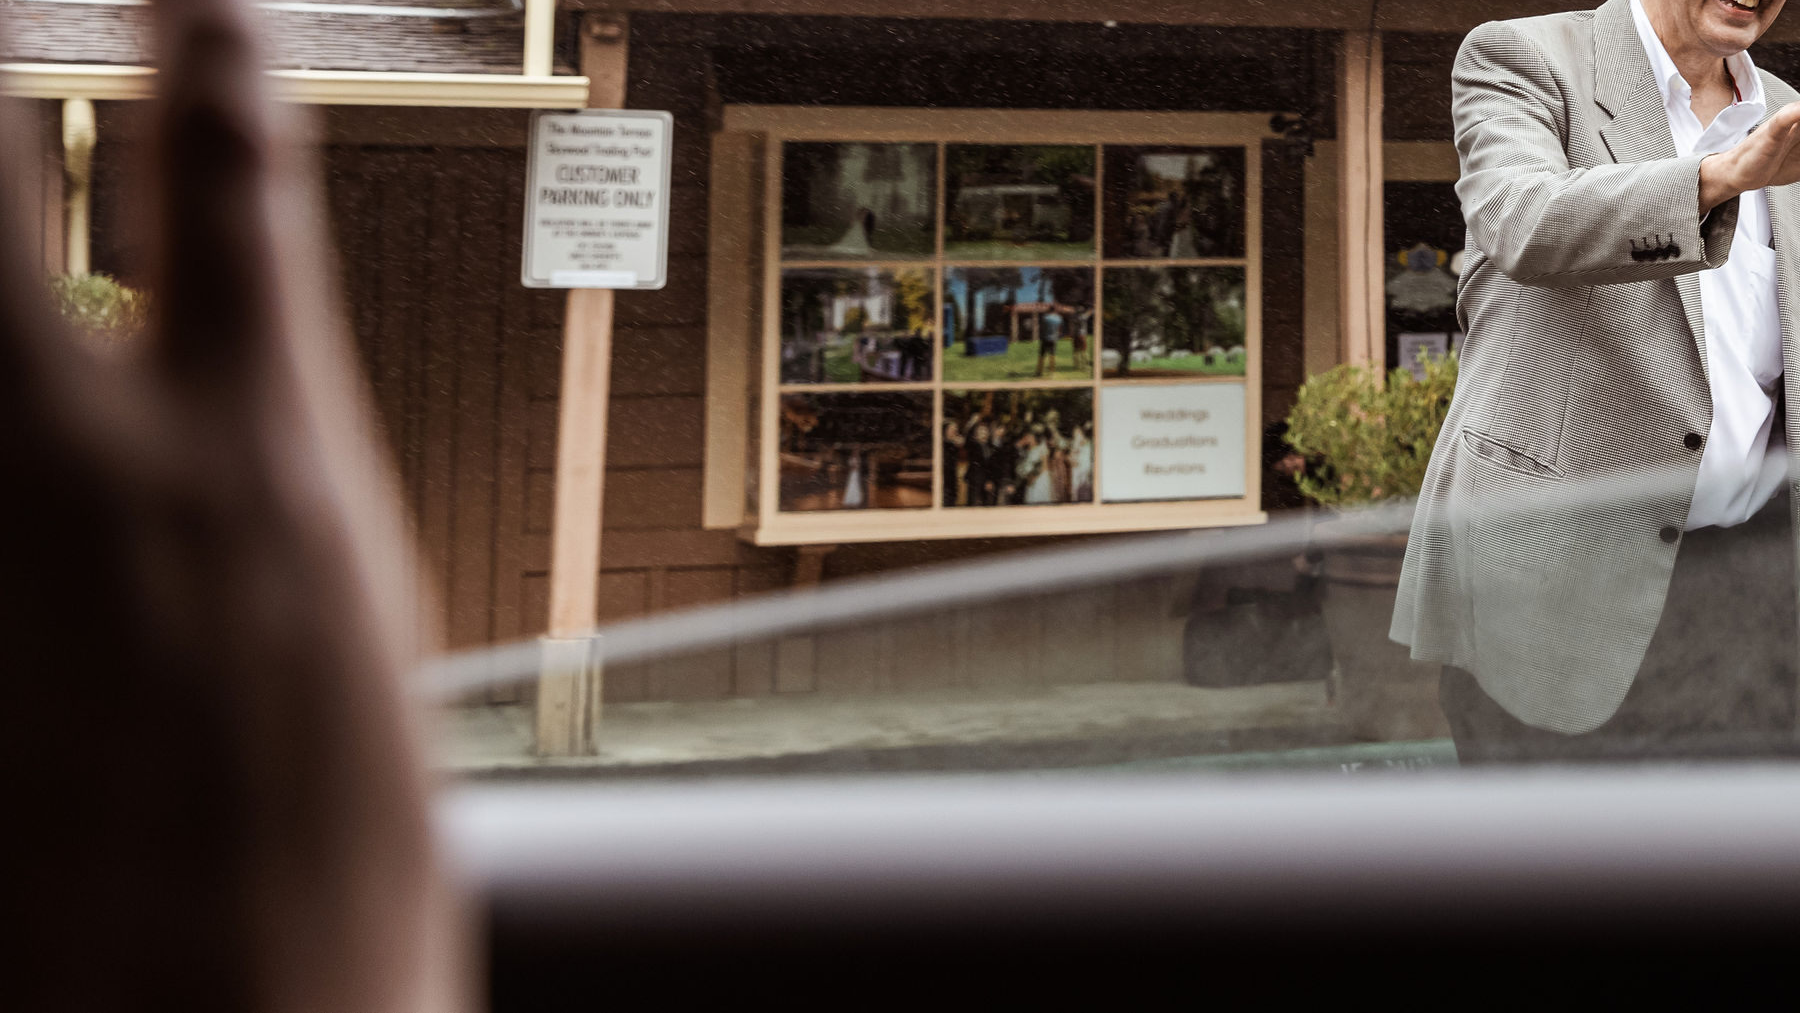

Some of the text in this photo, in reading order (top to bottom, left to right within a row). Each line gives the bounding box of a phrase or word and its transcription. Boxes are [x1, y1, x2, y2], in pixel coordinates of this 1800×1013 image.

[556, 164, 640, 184] CUSTOMER
[539, 186, 656, 209] PARKING ONLY
[1140, 409, 1209, 422] Weddings
[1132, 435, 1217, 449] Graduations
[1145, 463, 1205, 475] Reunions
